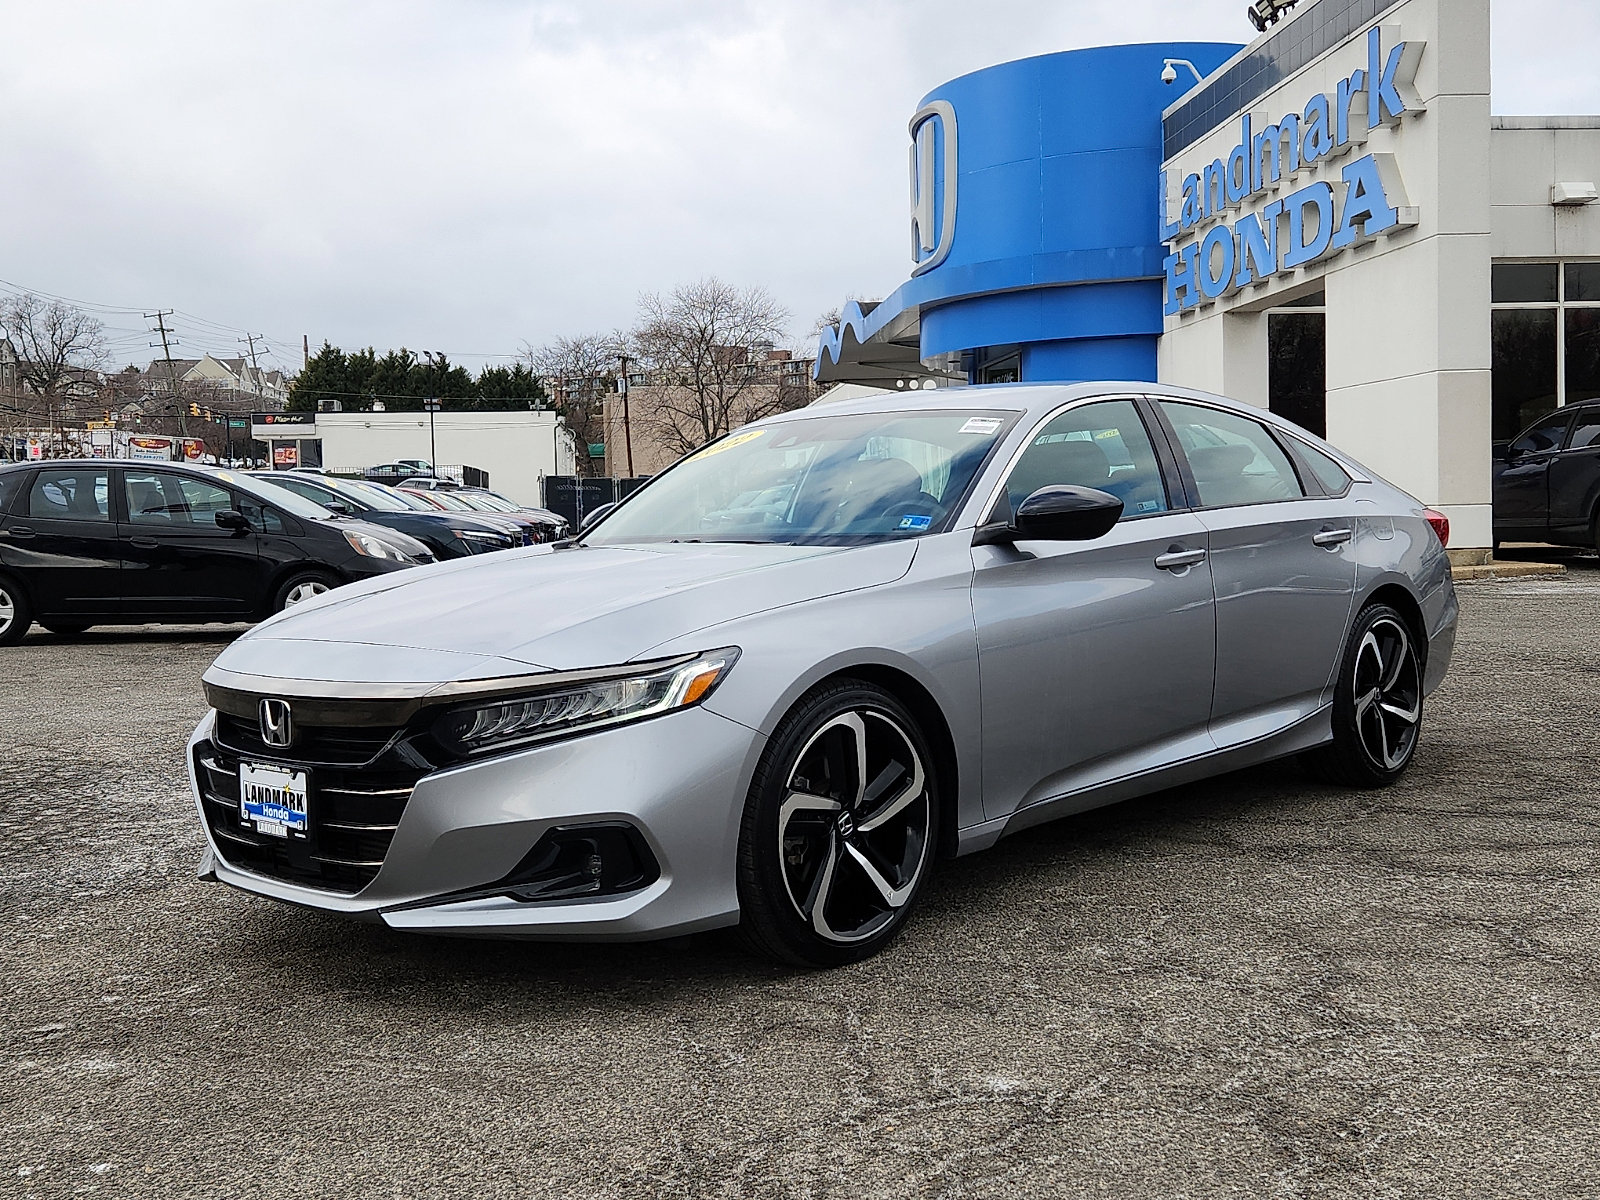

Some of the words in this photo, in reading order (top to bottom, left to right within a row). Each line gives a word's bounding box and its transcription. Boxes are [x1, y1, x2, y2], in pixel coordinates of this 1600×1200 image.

[1159, 26, 1408, 243] Landmark
[1163, 153, 1400, 316] HONDA
[244, 783, 305, 813] LANDMARK
[262, 804, 290, 820] Honda
